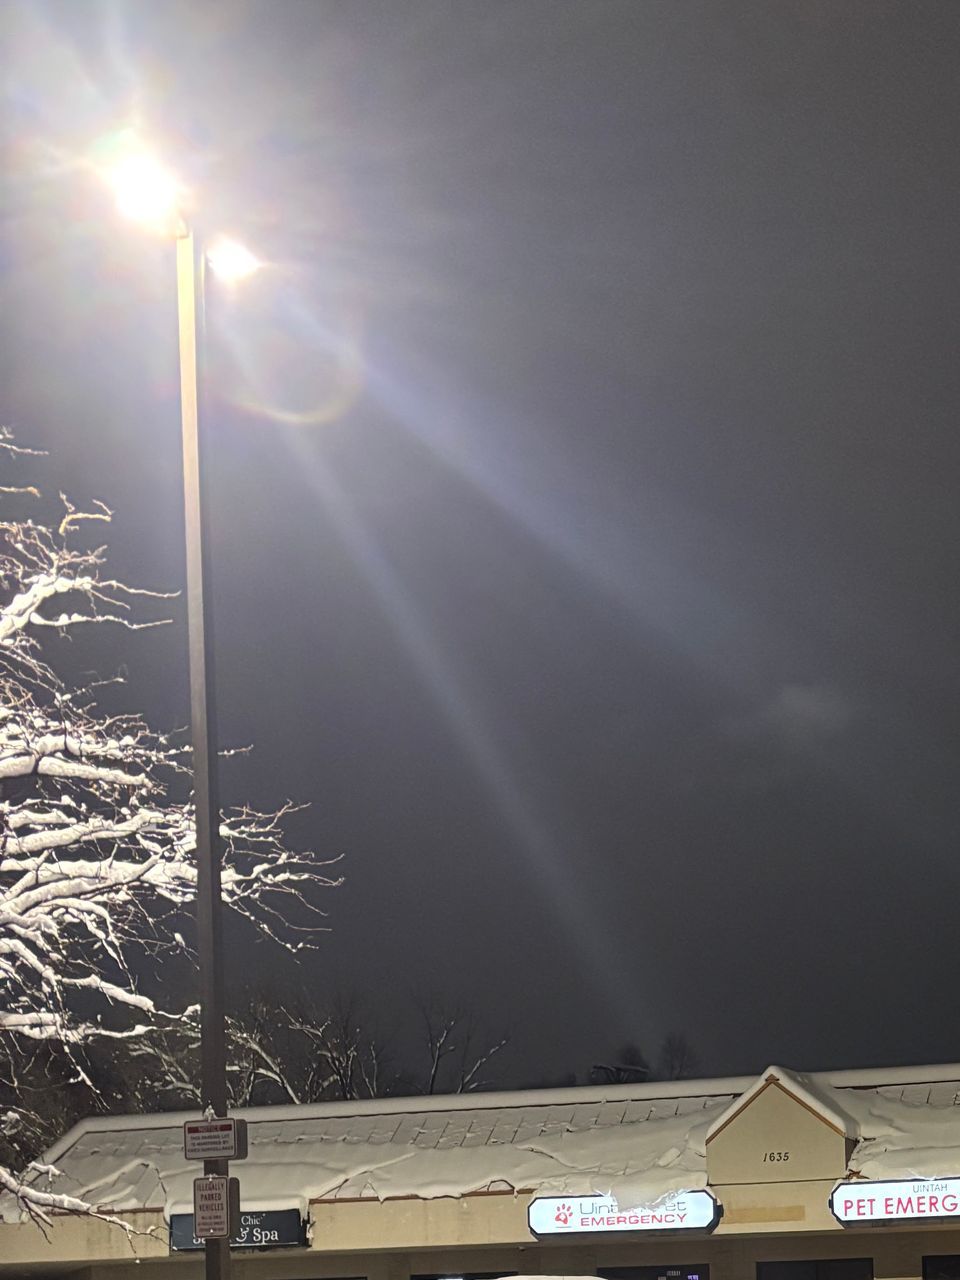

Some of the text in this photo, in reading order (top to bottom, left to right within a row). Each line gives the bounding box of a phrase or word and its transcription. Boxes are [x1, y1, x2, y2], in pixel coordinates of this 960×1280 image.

[763, 1152, 790, 1162] 1635
[197, 1182, 224, 1191] ILLEGALLY
[912, 1183, 948, 1193] UINTAH
[200, 1193, 222, 1201] PARKED
[199, 1203, 224, 1212] VEHICLES
[843, 1198, 876, 1217] PET
[241, 1215, 261, 1226] Chic
[580, 1213, 688, 1227] EMERGENCY
[235, 1227, 251, 1243] &
[253, 1227, 279, 1244] Spa
